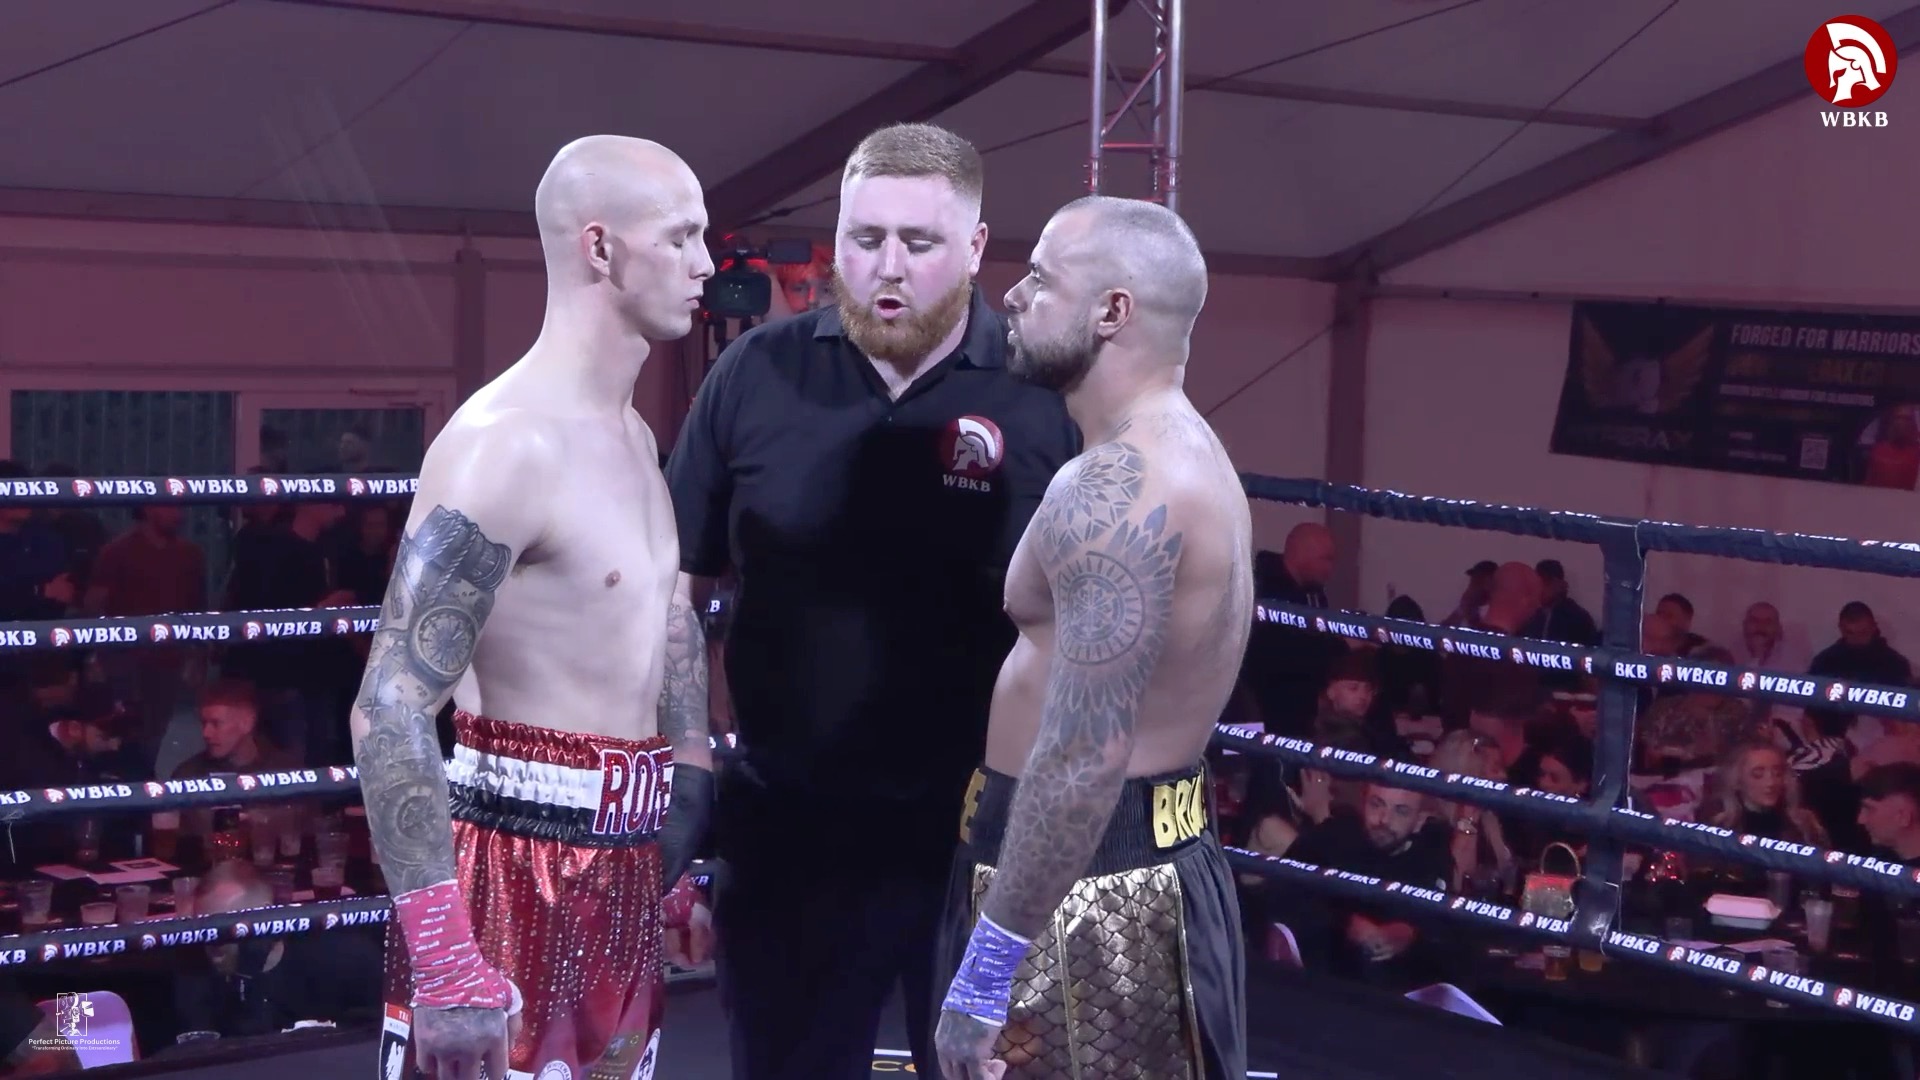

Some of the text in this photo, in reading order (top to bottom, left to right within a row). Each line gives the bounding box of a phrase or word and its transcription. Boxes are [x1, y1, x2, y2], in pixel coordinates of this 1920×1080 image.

[1731, 324, 1920, 355] FORGED FOR WARRIORS
[93, 479, 157, 496] WBKB
[186, 478, 249, 494] WBKB
[280, 478, 336, 494] WBKB
[942, 474, 991, 492] WBKB
[72, 626, 138, 644] WBKB
[264, 620, 322, 637] WBKB
[1267, 608, 1307, 629] WBKB
[1327, 620, 1368, 639] WBKB
[1389, 631, 1434, 650] WBKB
[1454, 641, 1501, 660] WBKB
[1525, 651, 1572, 670] WBKB
[1676, 666, 1728, 686] WBKB
[1759, 675, 1816, 696] WBKB
[1847, 687, 1908, 708] WBKB
[1273, 734, 1314, 753] WBKB
[65, 784, 133, 800] WBKB
[164, 777, 227, 794] WBKB
[256, 770, 318, 787] WBKB
[1153, 774, 1207, 848] BRU
[63, 939, 126, 958] WBKB
[160, 927, 218, 945] WBKB
[252, 917, 311, 936] WBKB
[1464, 898, 1512, 921] WBKB
[1608, 930, 1661, 955] WBKB
[1686, 947, 1741, 974] WBKB
[1769, 970, 1825, 997] WBKB
[1855, 993, 1915, 1022] WBKB
